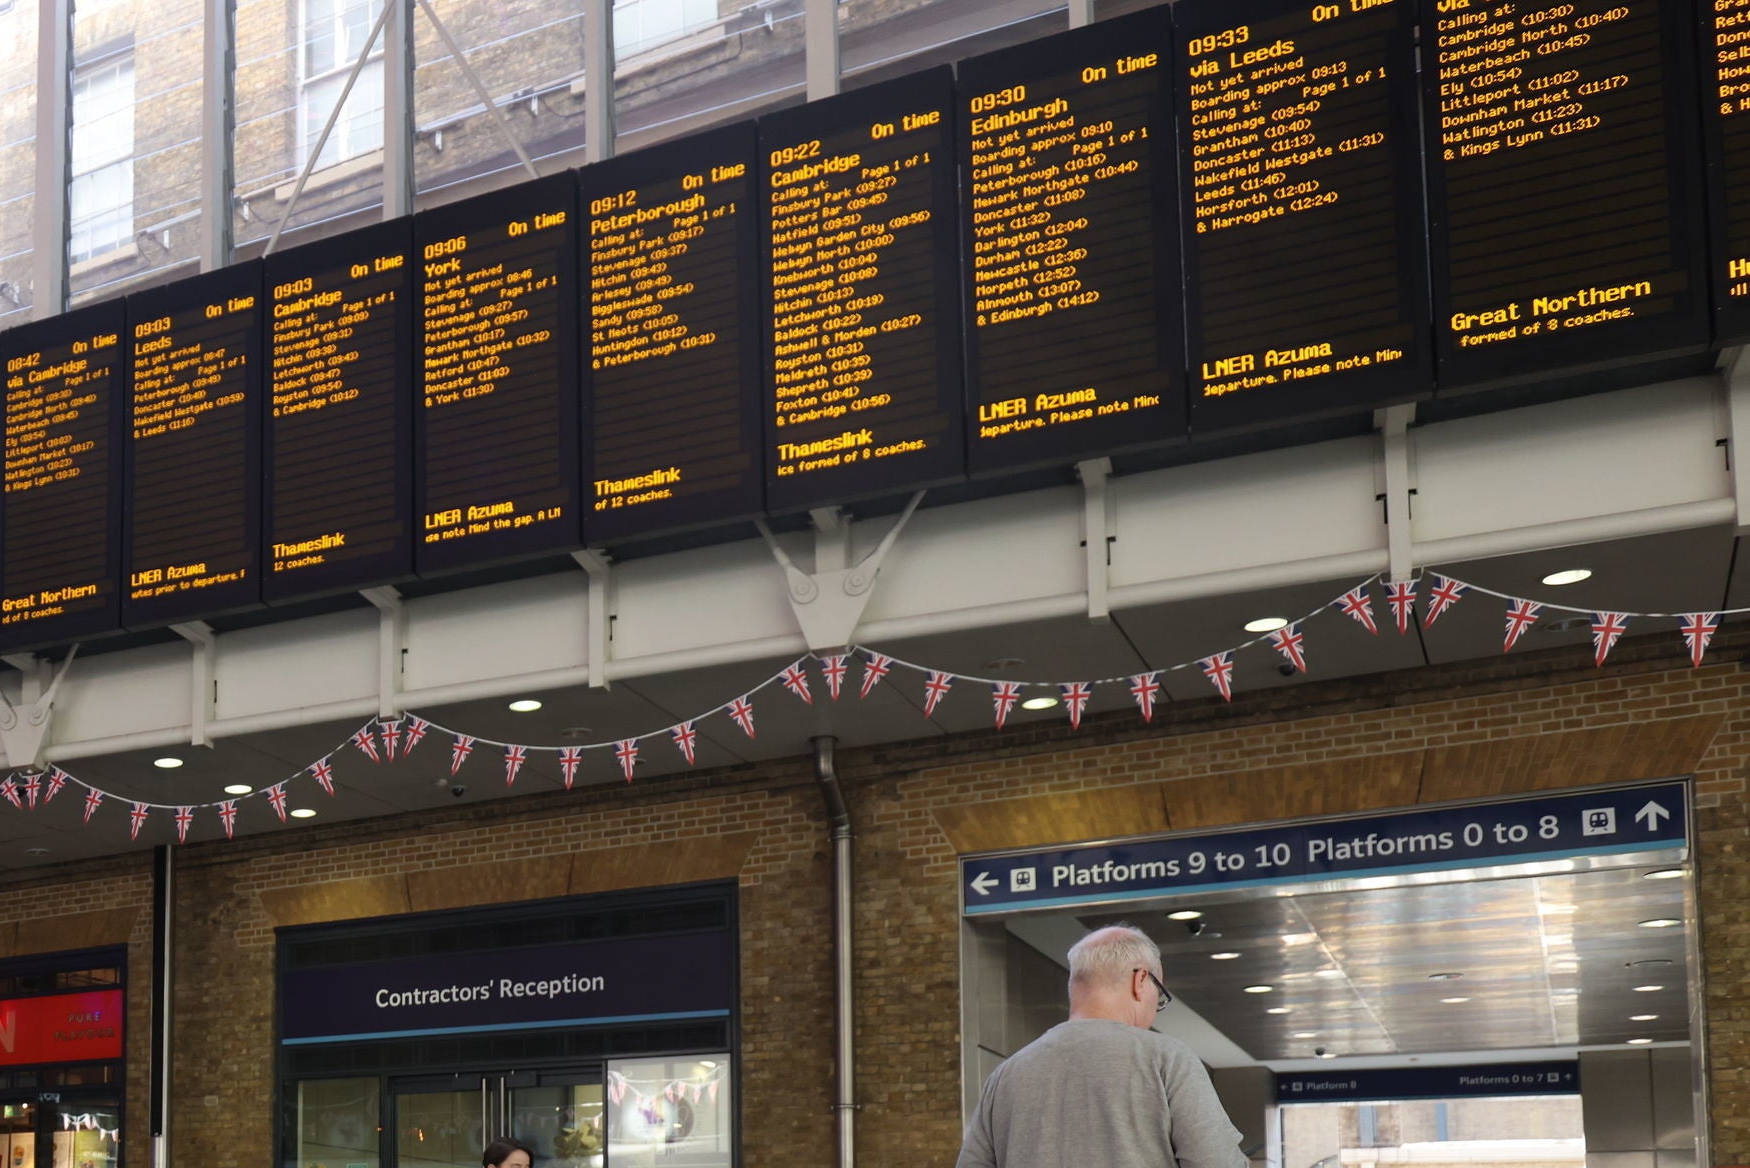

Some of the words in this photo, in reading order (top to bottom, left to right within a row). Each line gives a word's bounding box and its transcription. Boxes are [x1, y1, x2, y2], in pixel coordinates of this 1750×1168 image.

[1188, 25, 1249, 57] 09:33
[1311, 4, 1340, 23] On
[1188, 58, 1221, 79] via
[1228, 38, 1295, 69] Leeds
[1438, 47, 1531, 80] Waterbeach
[1535, 32, 1591, 56] (10:45)
[969, 84, 1026, 114] 09:30
[1080, 65, 1107, 84] On
[1114, 52, 1158, 75] time
[1189, 87, 1251, 112] Boarding
[1254, 74, 1307, 95] approx
[1310, 60, 1347, 80] 09:13
[1438, 81, 1465, 97] Ely
[1468, 66, 1523, 89] (10:54)
[969, 96, 1069, 136] Edinburgh
[769, 138, 821, 168] 09:22
[869, 122, 895, 140] On
[900, 110, 941, 132] time
[1442, 147, 1455, 161] &
[1458, 138, 1501, 157] Kings
[1504, 129, 1545, 148] Lynn
[1547, 114, 1601, 136] (11:31)
[769, 152, 861, 188] Cambridge
[589, 188, 638, 216] 09:12
[680, 173, 705, 191] On
[709, 162, 746, 183] time
[589, 192, 707, 236] Peterborough
[1195, 220, 1207, 234] &
[1210, 204, 1285, 231] Harrogate
[1288, 190, 1339, 212] (12:24)
[422, 234, 467, 261] 09:06
[506, 220, 529, 237] On
[532, 210, 567, 230] time
[973, 248, 1021, 269] Durham
[1023, 236, 1069, 257] (12:22)
[272, 276, 314, 300] 09:03
[349, 263, 370, 279] On
[372, 254, 405, 273] time
[423, 256, 462, 278] York
[133, 315, 172, 339] 09:03
[203, 303, 224, 319] On
[225, 295, 255, 313] time
[272, 289, 343, 319] Cambridge
[590, 314, 624, 330] Sandy
[623, 302, 664, 321] (09:58)
[975, 313, 987, 327] &
[988, 300, 1053, 325] Edinburgh
[1055, 290, 1100, 309] (14:12)
[1449, 301, 1521, 332] Great
[1530, 280, 1652, 317] Northern
[5, 351, 41, 373] 08:42
[70, 340, 89, 355] On
[90, 332, 118, 349] time
[133, 335, 173, 356] Leeds
[1200, 352, 1255, 381] LNER
[1262, 341, 1333, 369] Azuma
[5, 374, 25, 389] via
[26, 358, 89, 384] Cambridge
[423, 396, 434, 408] &
[434, 391, 461, 404] York
[461, 382, 495, 399] (11:30)
[774, 395, 819, 412] Foxton
[819, 385, 861, 403] (10:41)
[977, 396, 1028, 423] LNER
[1033, 386, 1098, 412] Azuma
[776, 427, 874, 461] Thameslink
[592, 465, 682, 496] Thameslink
[423, 507, 463, 530] LNER
[465, 499, 515, 521] Azuma
[271, 531, 346, 559] Thameslink
[129, 567, 164, 588] LNER
[165, 561, 208, 580] Azuma
[0, 593, 37, 613] Great
[38, 583, 98, 605] Northern
[1308, 831, 1454, 862] Platforms
[1463, 822, 1483, 847] 0
[1493, 821, 1528, 844] to
[1538, 815, 1560, 839] 8
[1053, 859, 1180, 887] Platforms
[1188, 851, 1206, 875] 9
[1214, 850, 1245, 872] to
[1255, 843, 1291, 868] 10
[376, 979, 494, 1008] Contractors'
[500, 973, 605, 999] Reception
[67, 1011, 101, 1024] PURE
[1306, 1079, 1349, 1092] Platform
[1459, 1073, 1510, 1086] Platforms
[1511, 1073, 1520, 1083] 0
[1521, 1073, 1534, 1084] to
[1536, 1072, 1544, 1082] 7
